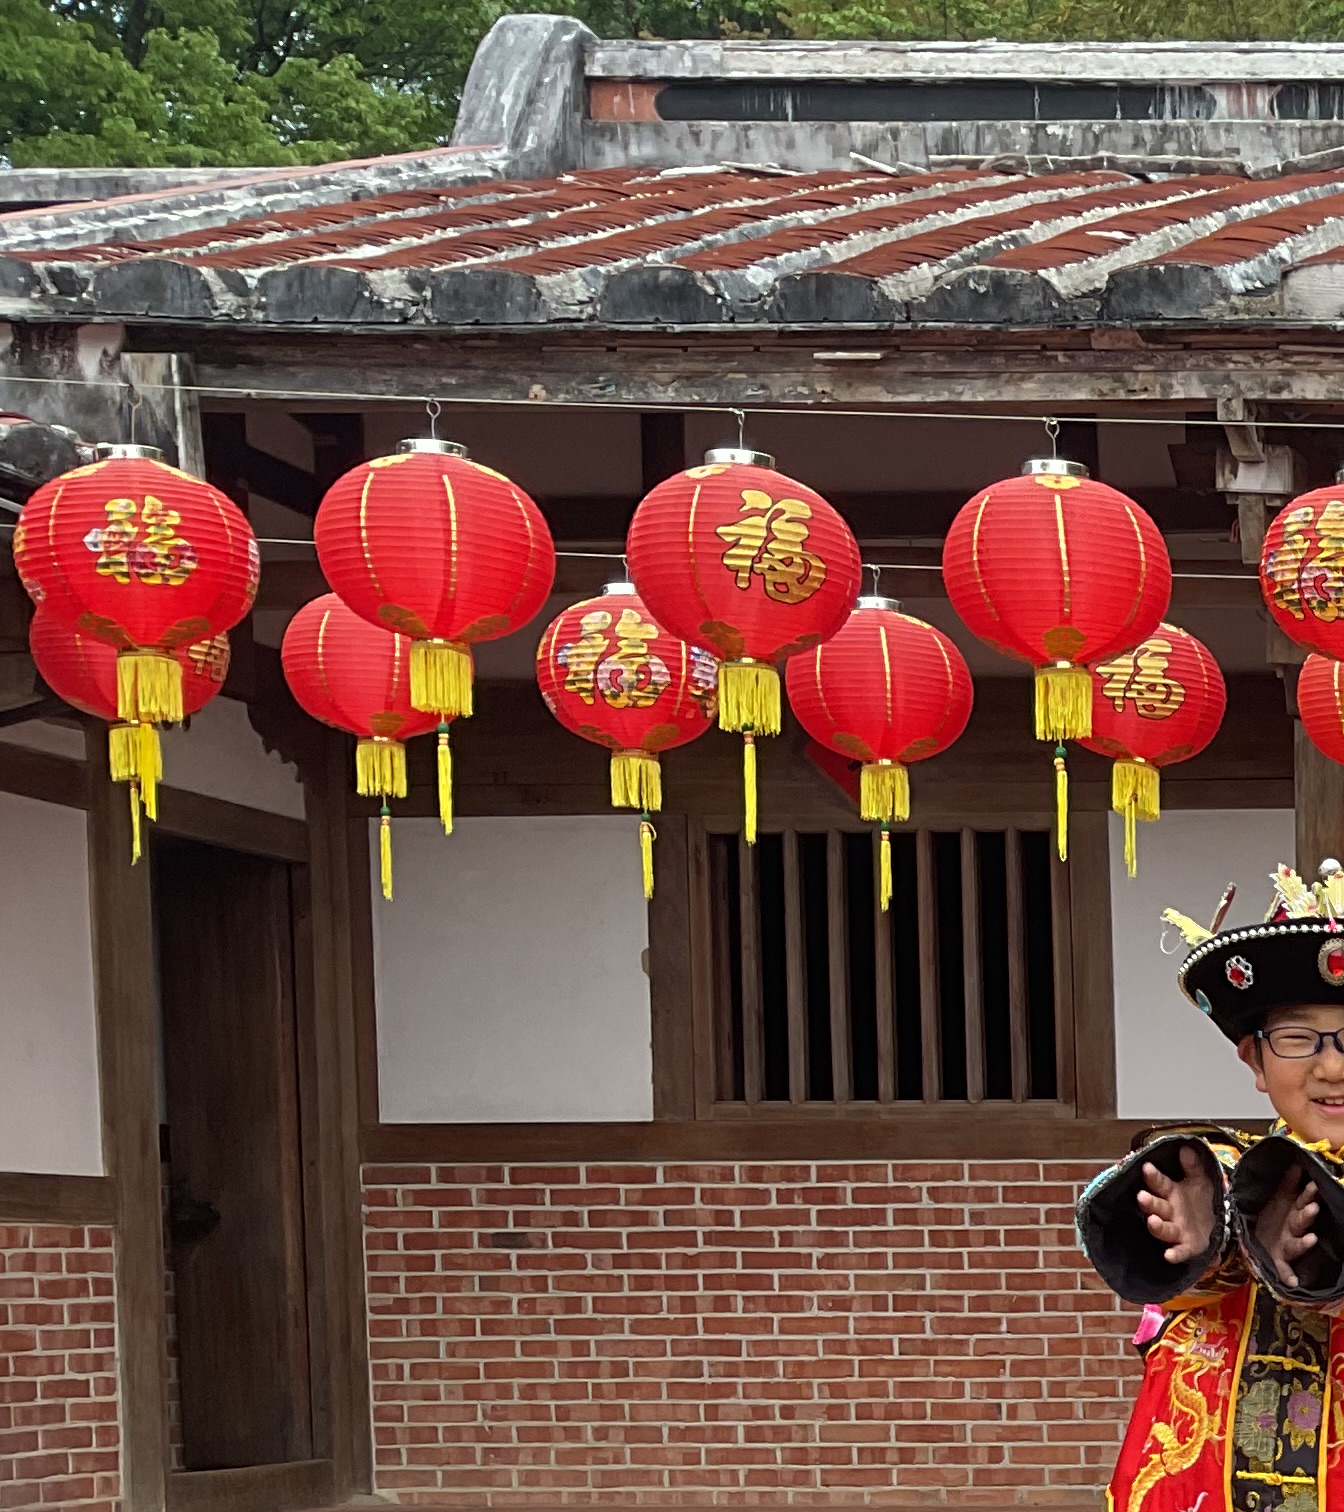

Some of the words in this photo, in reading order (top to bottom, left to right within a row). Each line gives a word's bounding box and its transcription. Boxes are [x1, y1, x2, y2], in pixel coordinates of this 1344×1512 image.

[83, 495, 199, 586] 福
[715, 489, 827, 605] 福
[557, 608, 672, 709] 福
[1095, 638, 1187, 720] 福
